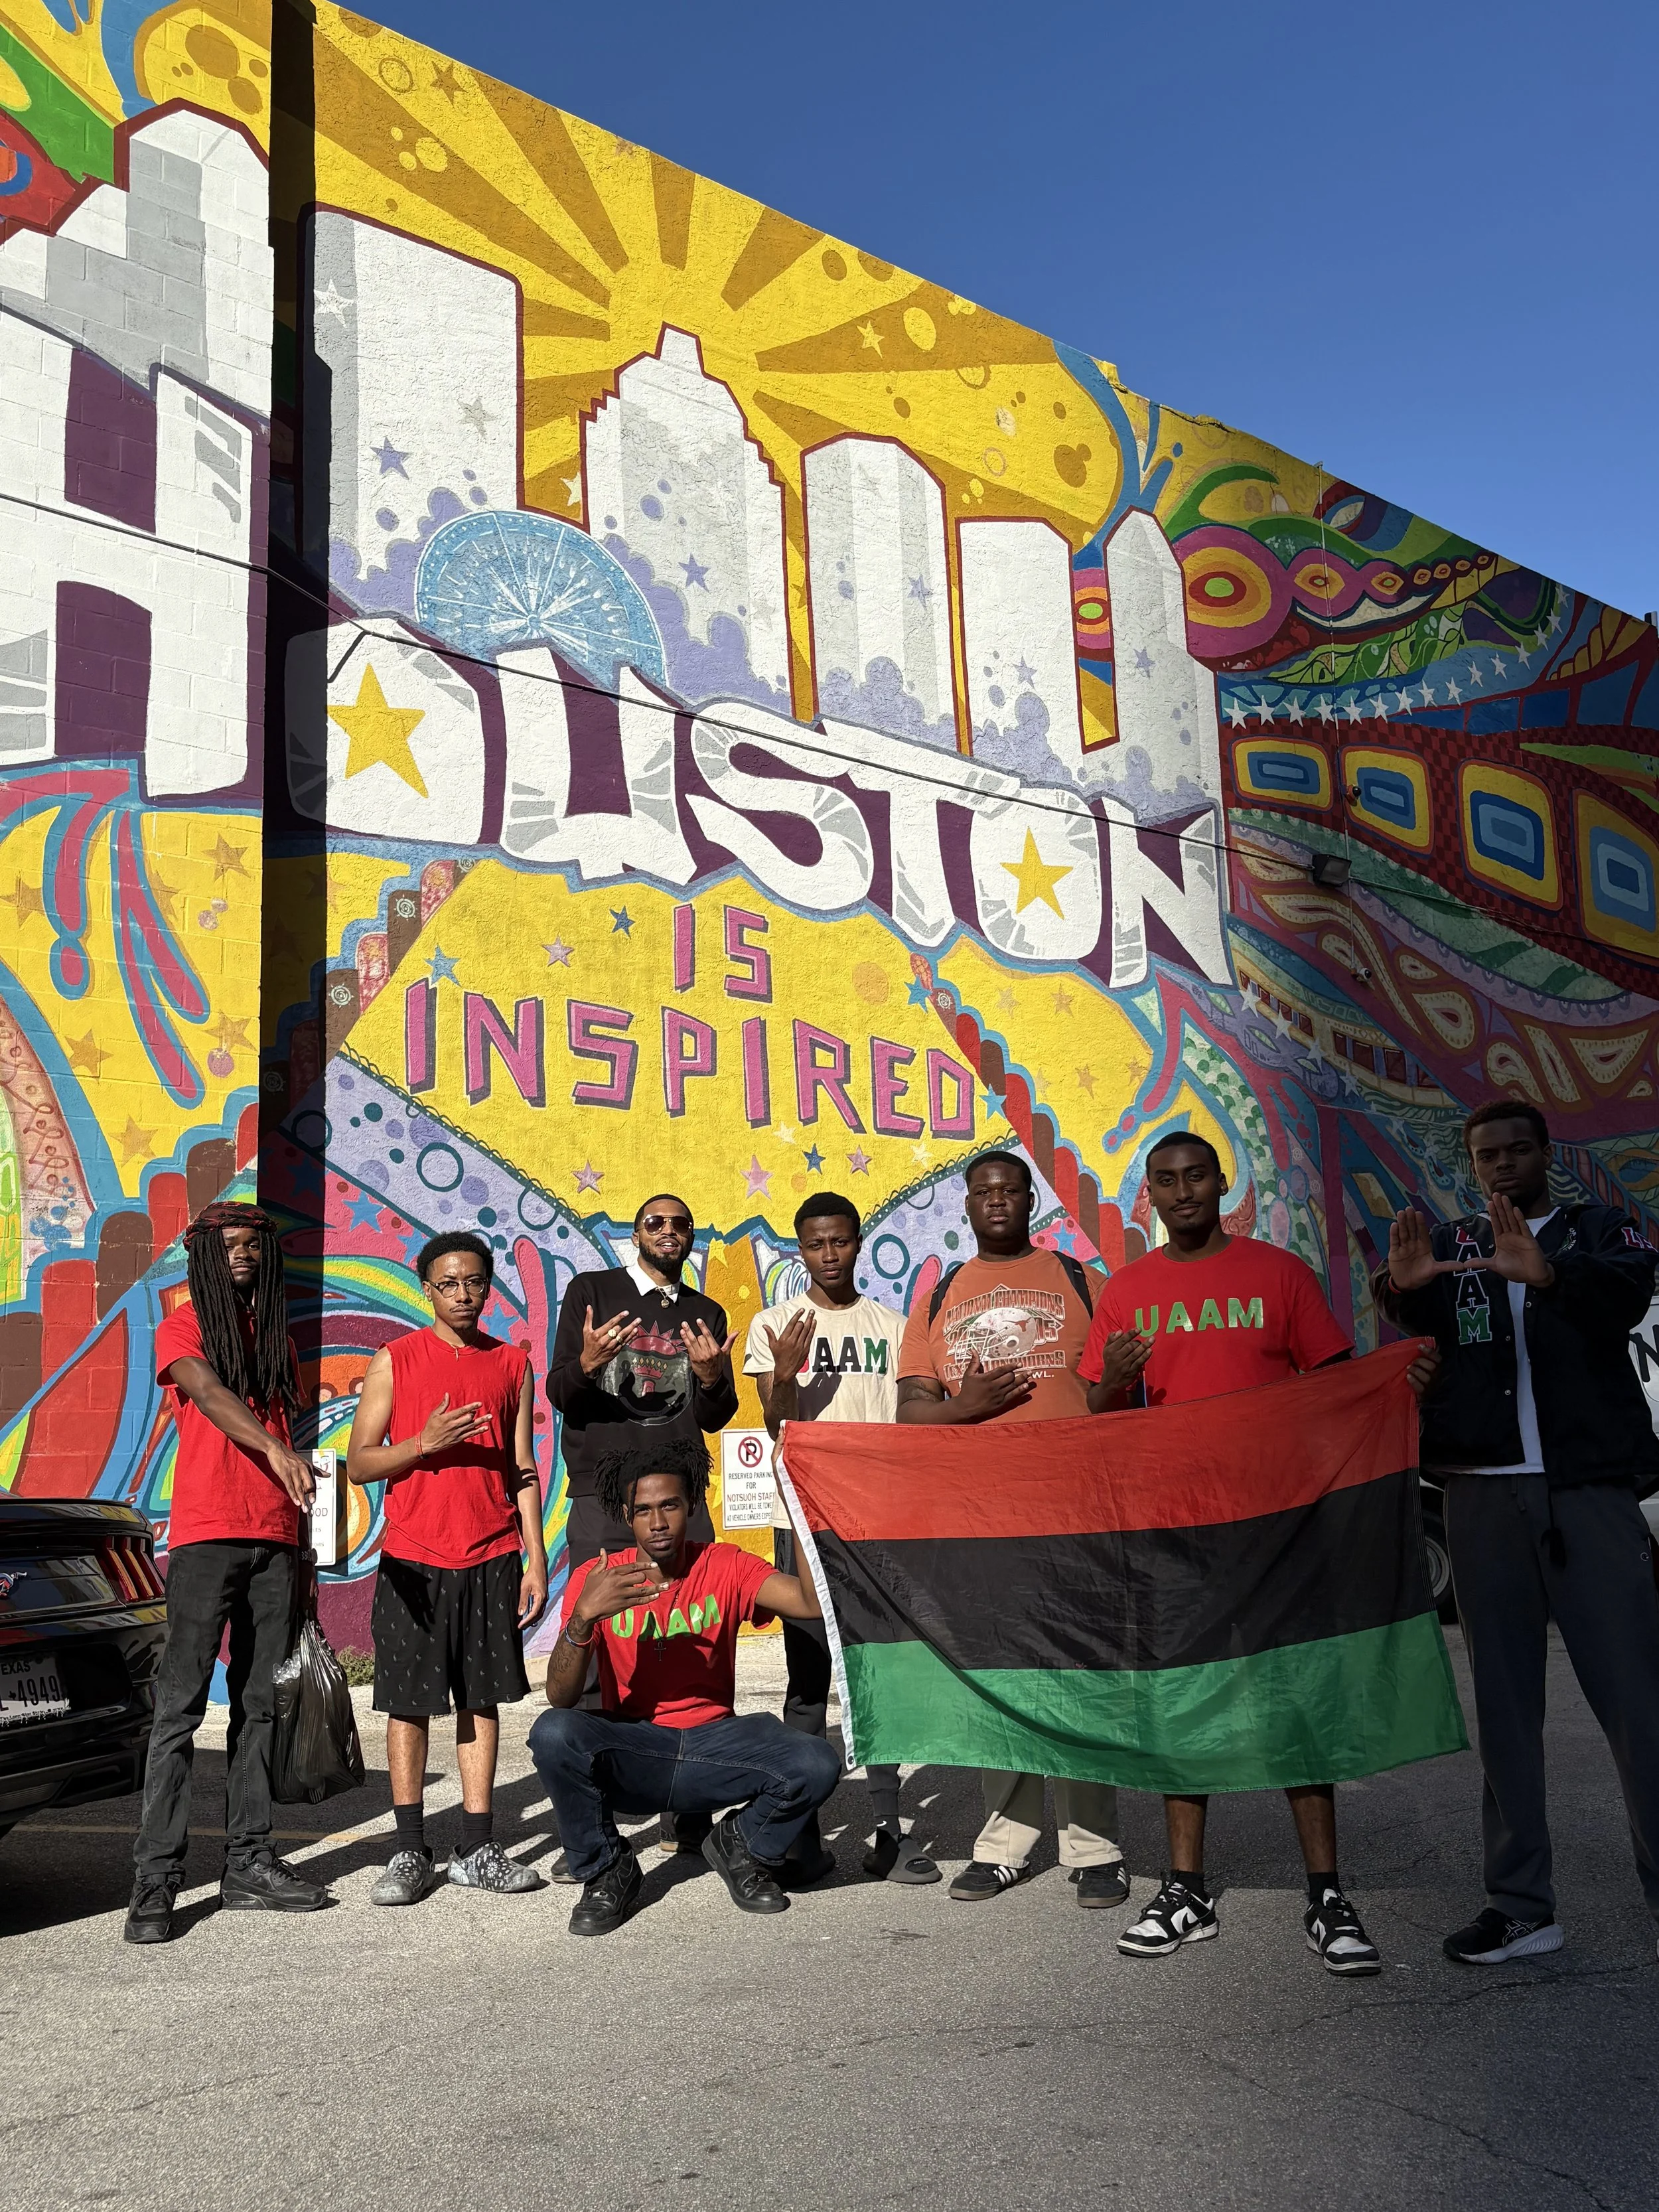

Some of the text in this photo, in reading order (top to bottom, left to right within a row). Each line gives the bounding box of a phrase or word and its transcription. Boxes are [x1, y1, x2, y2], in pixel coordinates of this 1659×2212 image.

[0, 311, 1233, 989] HOUSTON
[672, 903, 773, 1003] IS
[404, 978, 976, 1140] INSPIRED
[994, 1289, 1066, 1321] CHAMPIONS
[1135, 1297, 1264, 1337] UAAM
[798, 1335, 889, 1375] AAM
[943, 1363, 969, 1382] TEX
[1032, 1370, 1054, 1379] WL.
[308, 1507, 328, 1517] OOD
[727, 1493, 757, 1503] NOTSUOH
[611, 1594, 721, 1641] UAAM
[17, 1675, 60, 1708] 4949
